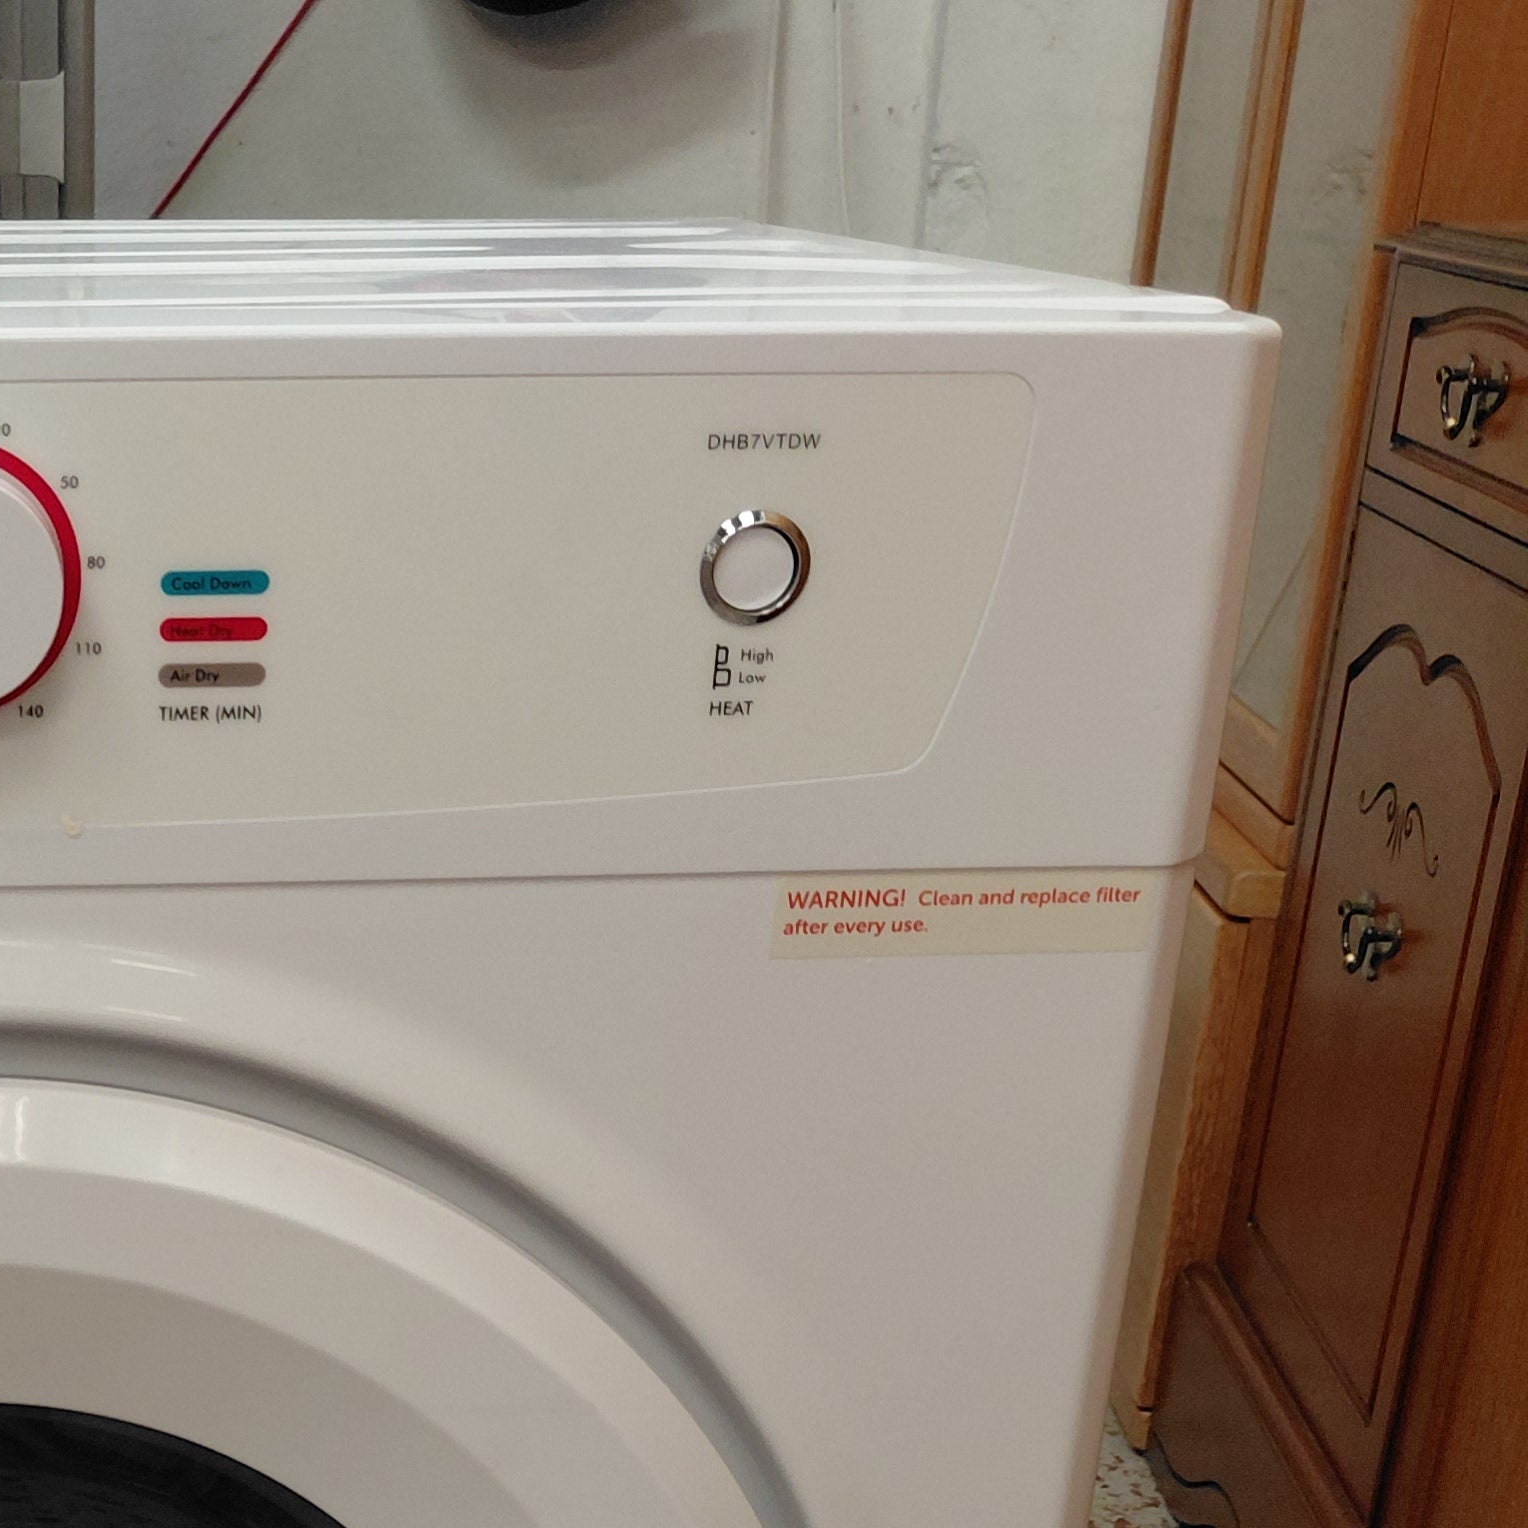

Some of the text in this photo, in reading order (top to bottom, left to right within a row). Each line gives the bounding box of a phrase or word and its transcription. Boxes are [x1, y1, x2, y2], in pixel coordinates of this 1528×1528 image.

[707, 433, 821, 450] DHB7VTDW
[59, 475, 79, 490] 50
[86, 555, 106, 570] 80
[171, 577, 251, 590] Cool Down
[209, 624, 233, 639] Dry
[75, 641, 102, 656] 110
[740, 648, 774, 664] High
[170, 668, 219, 684] Air Dry
[738, 671, 766, 685] Low
[17, 704, 44, 719] 140
[159, 704, 263, 723] TIMER (MIN)
[709, 701, 754, 717] HEAT
[787, 886, 1141, 909] WARNING! Clean and replace filter
[783, 917, 928, 938] after every use.
